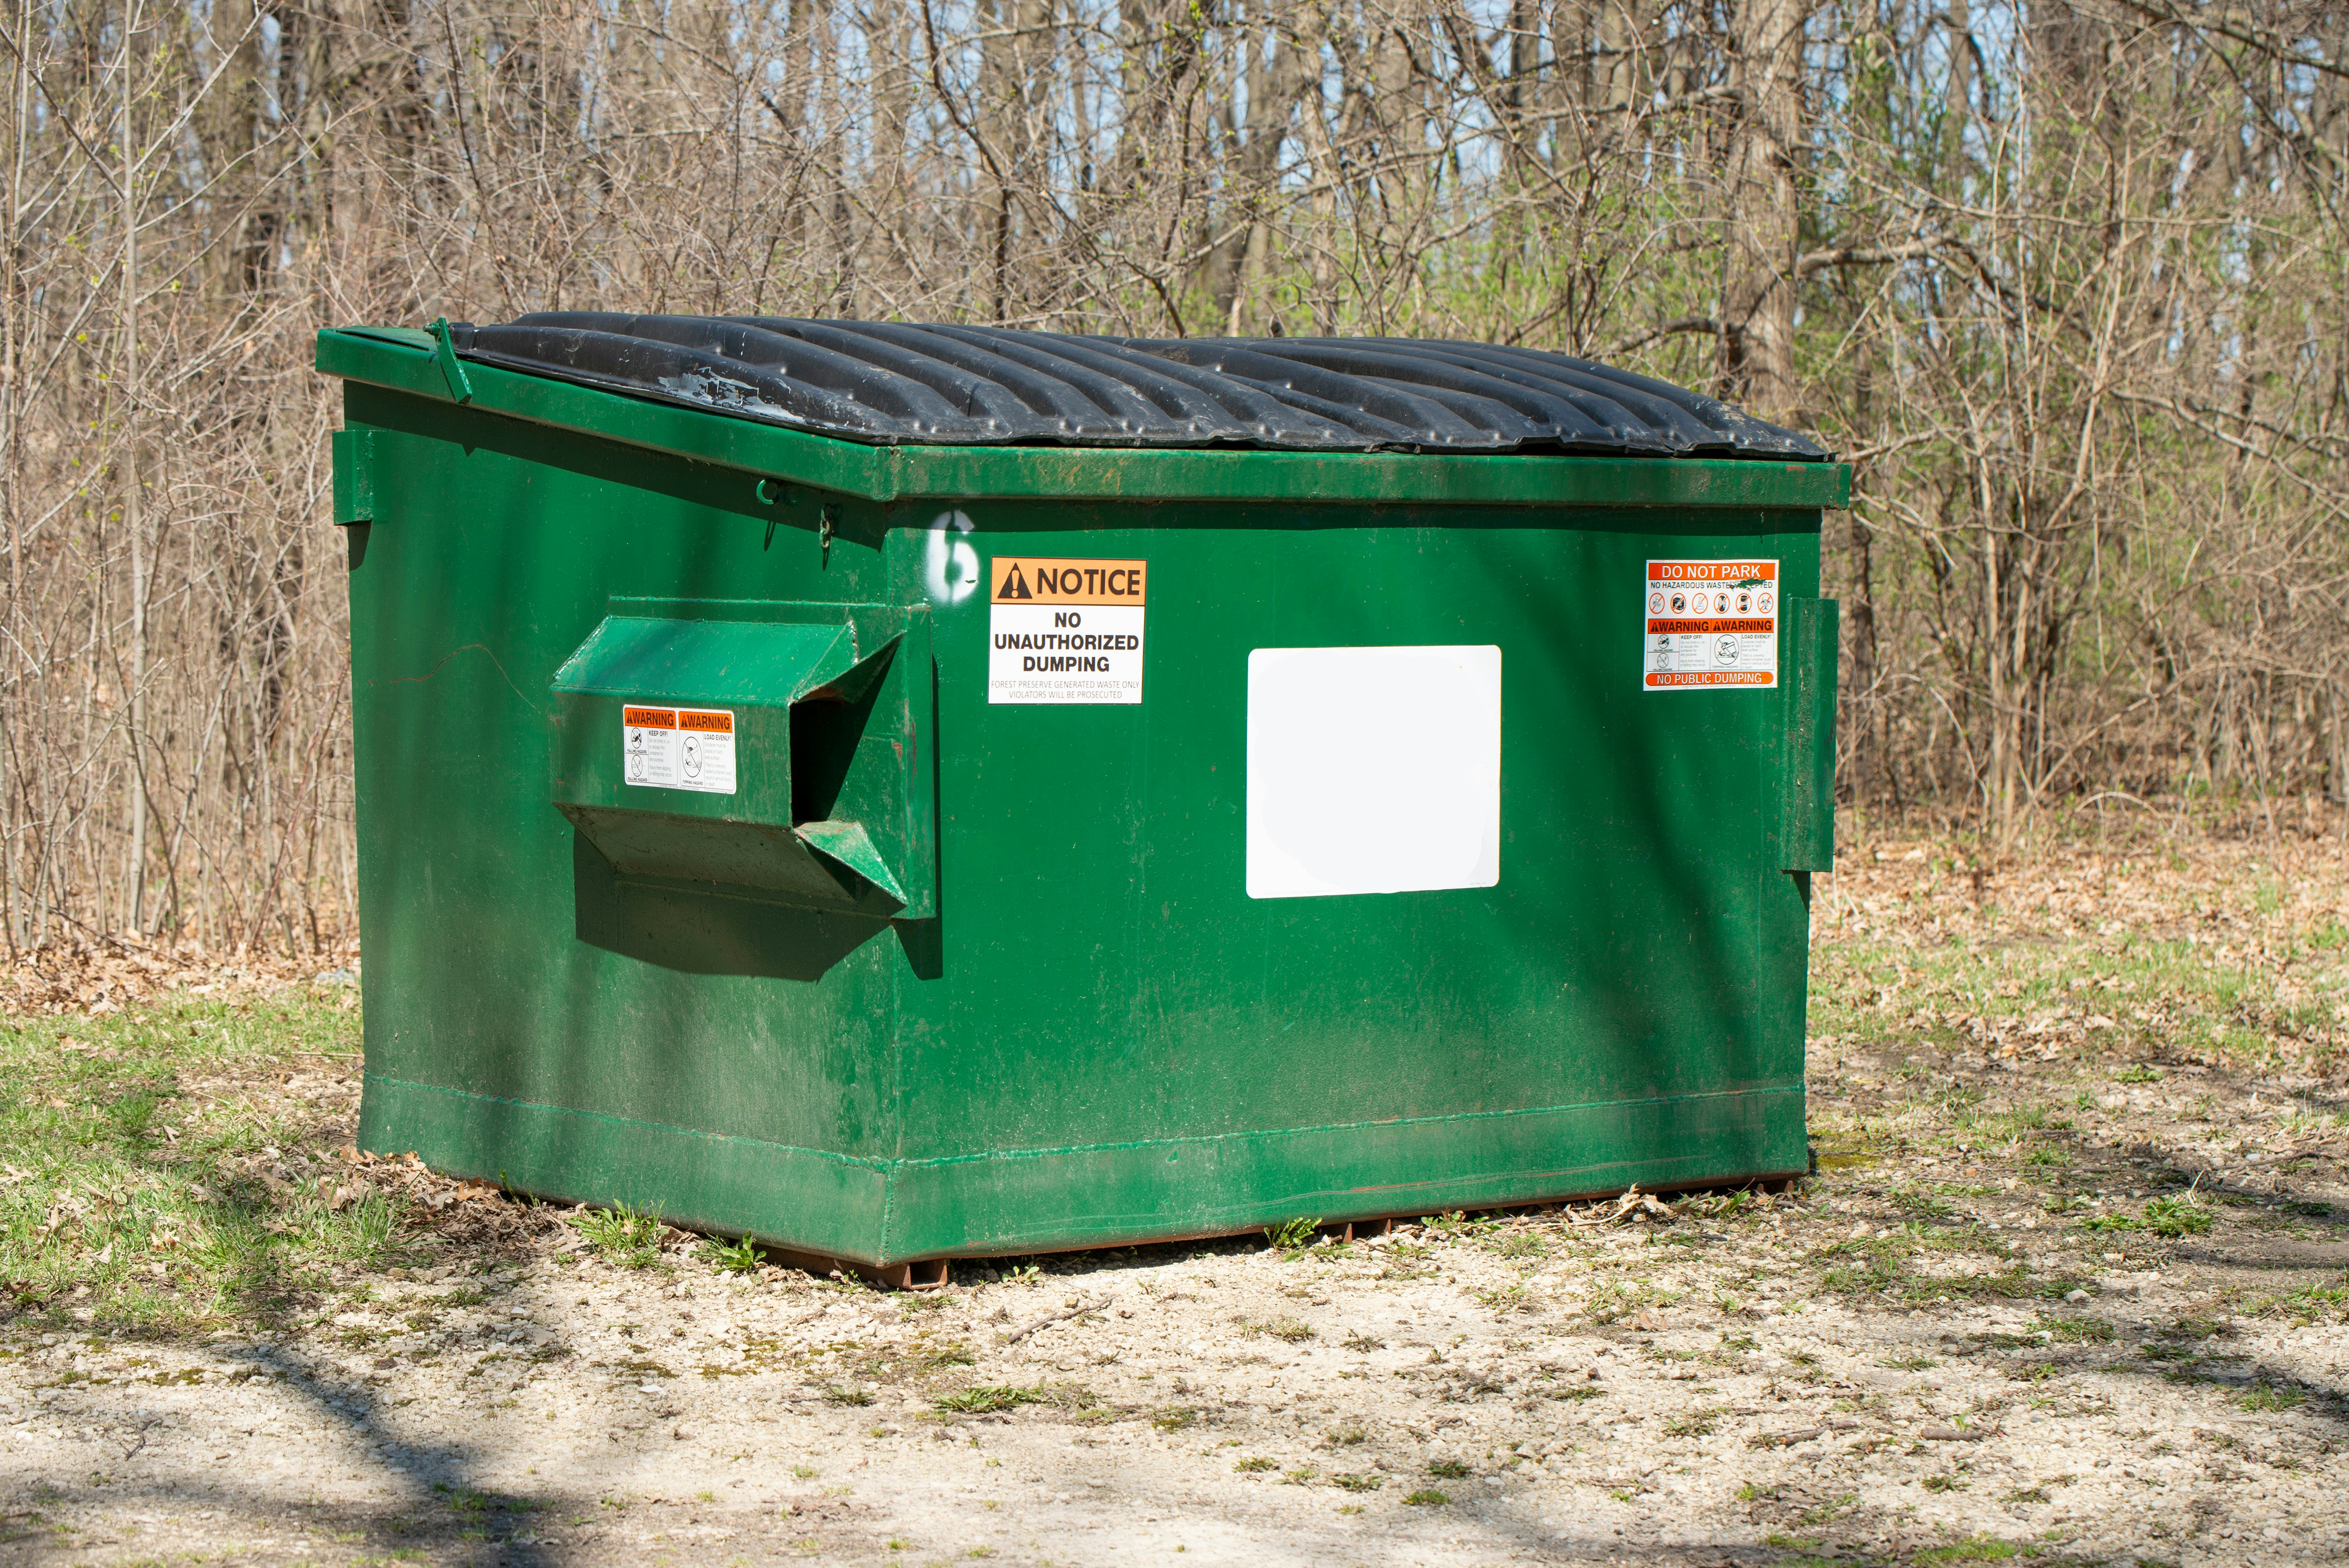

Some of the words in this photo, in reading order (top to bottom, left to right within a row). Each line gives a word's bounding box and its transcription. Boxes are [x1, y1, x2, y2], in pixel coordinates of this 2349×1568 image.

[926, 509, 979, 604] 6
[1662, 565, 1682, 578] DO
[1687, 565, 1718, 578] NOT
[1722, 564, 1761, 578] PARK
[1037, 568, 1140, 595] NOTICE
[1055, 613, 1081, 628] NO
[1659, 621, 1709, 632] WARNING
[1721, 620, 1772, 631] WARNING
[995, 634, 1139, 650] UNAUTHORIZED
[1024, 657, 1109, 672] DUMPING
[1657, 674, 1671, 684] NO
[1675, 673, 1711, 684] PUBLIC
[1715, 673, 1762, 683] DUMPING
[632, 711, 674, 726] WARNING
[687, 714, 730, 730] WARNING
